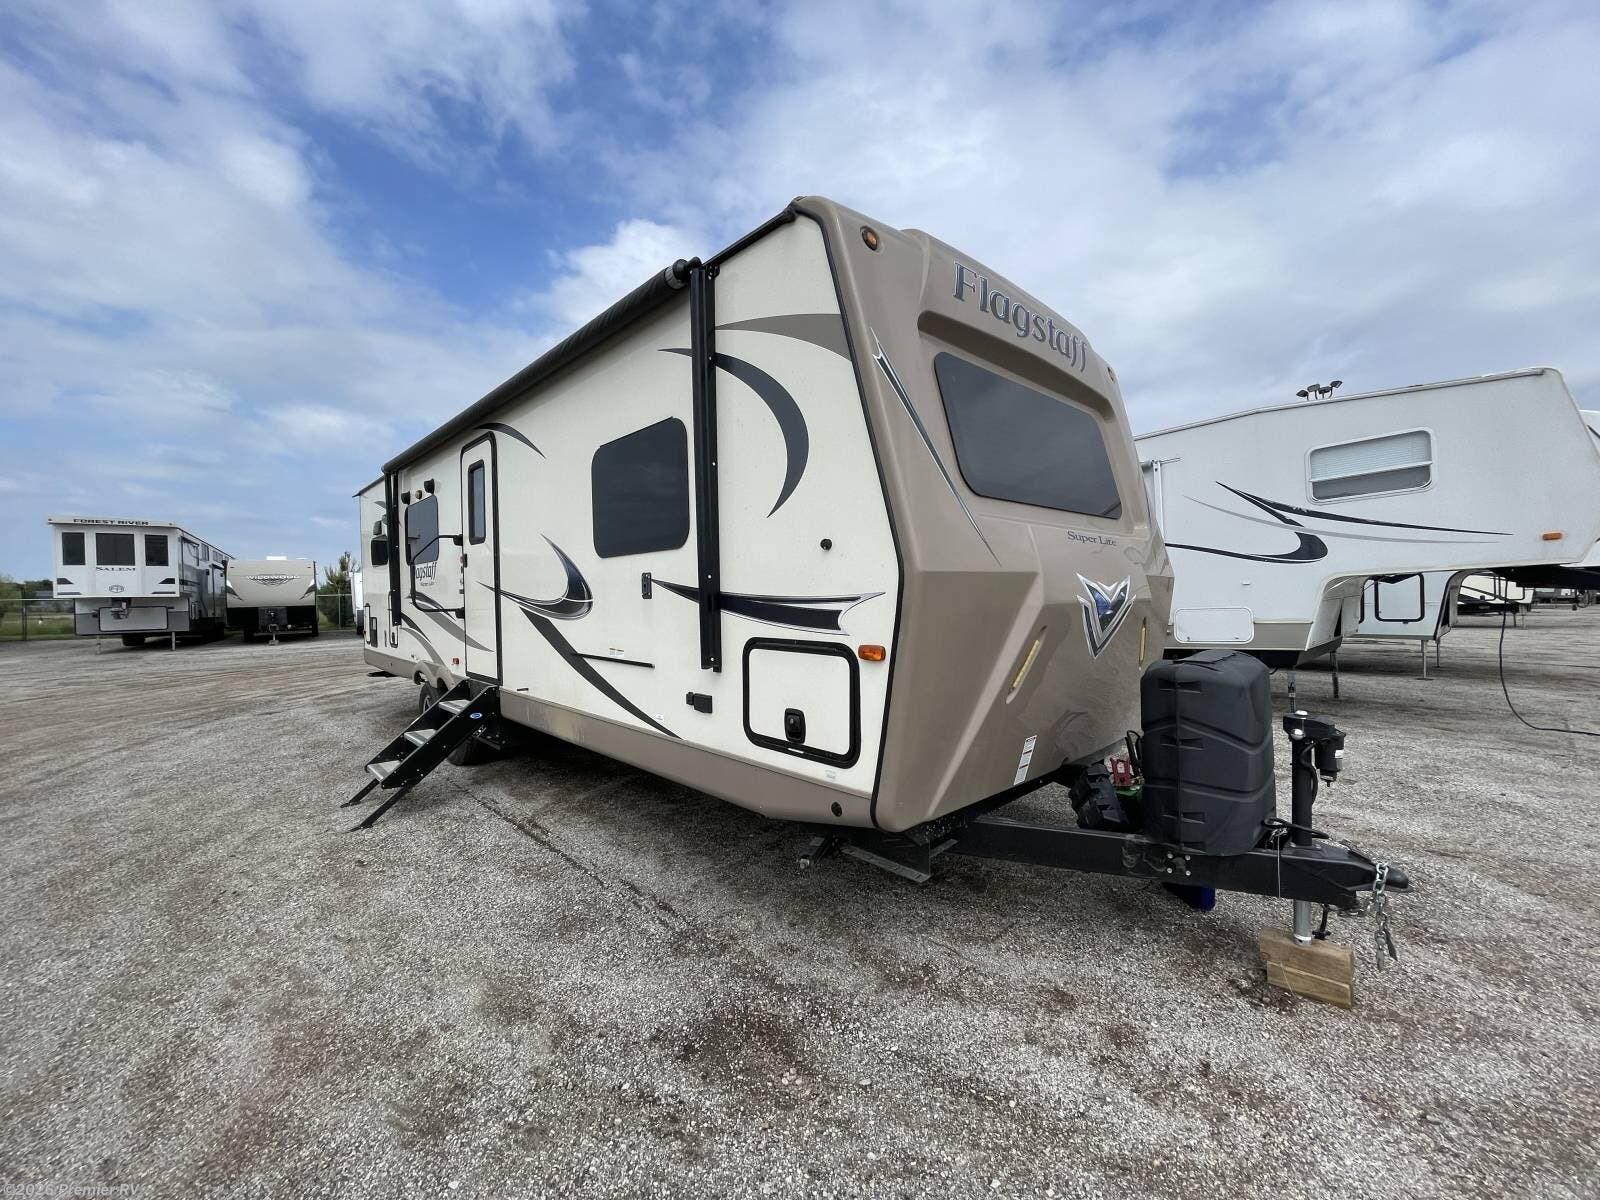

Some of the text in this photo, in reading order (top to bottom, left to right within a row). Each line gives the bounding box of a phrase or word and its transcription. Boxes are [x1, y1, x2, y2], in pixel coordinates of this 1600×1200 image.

[952, 261, 1087, 371] Flagstaff
[1067, 531, 1117, 546] Super Lite
[416, 562, 437, 581] agstaff
